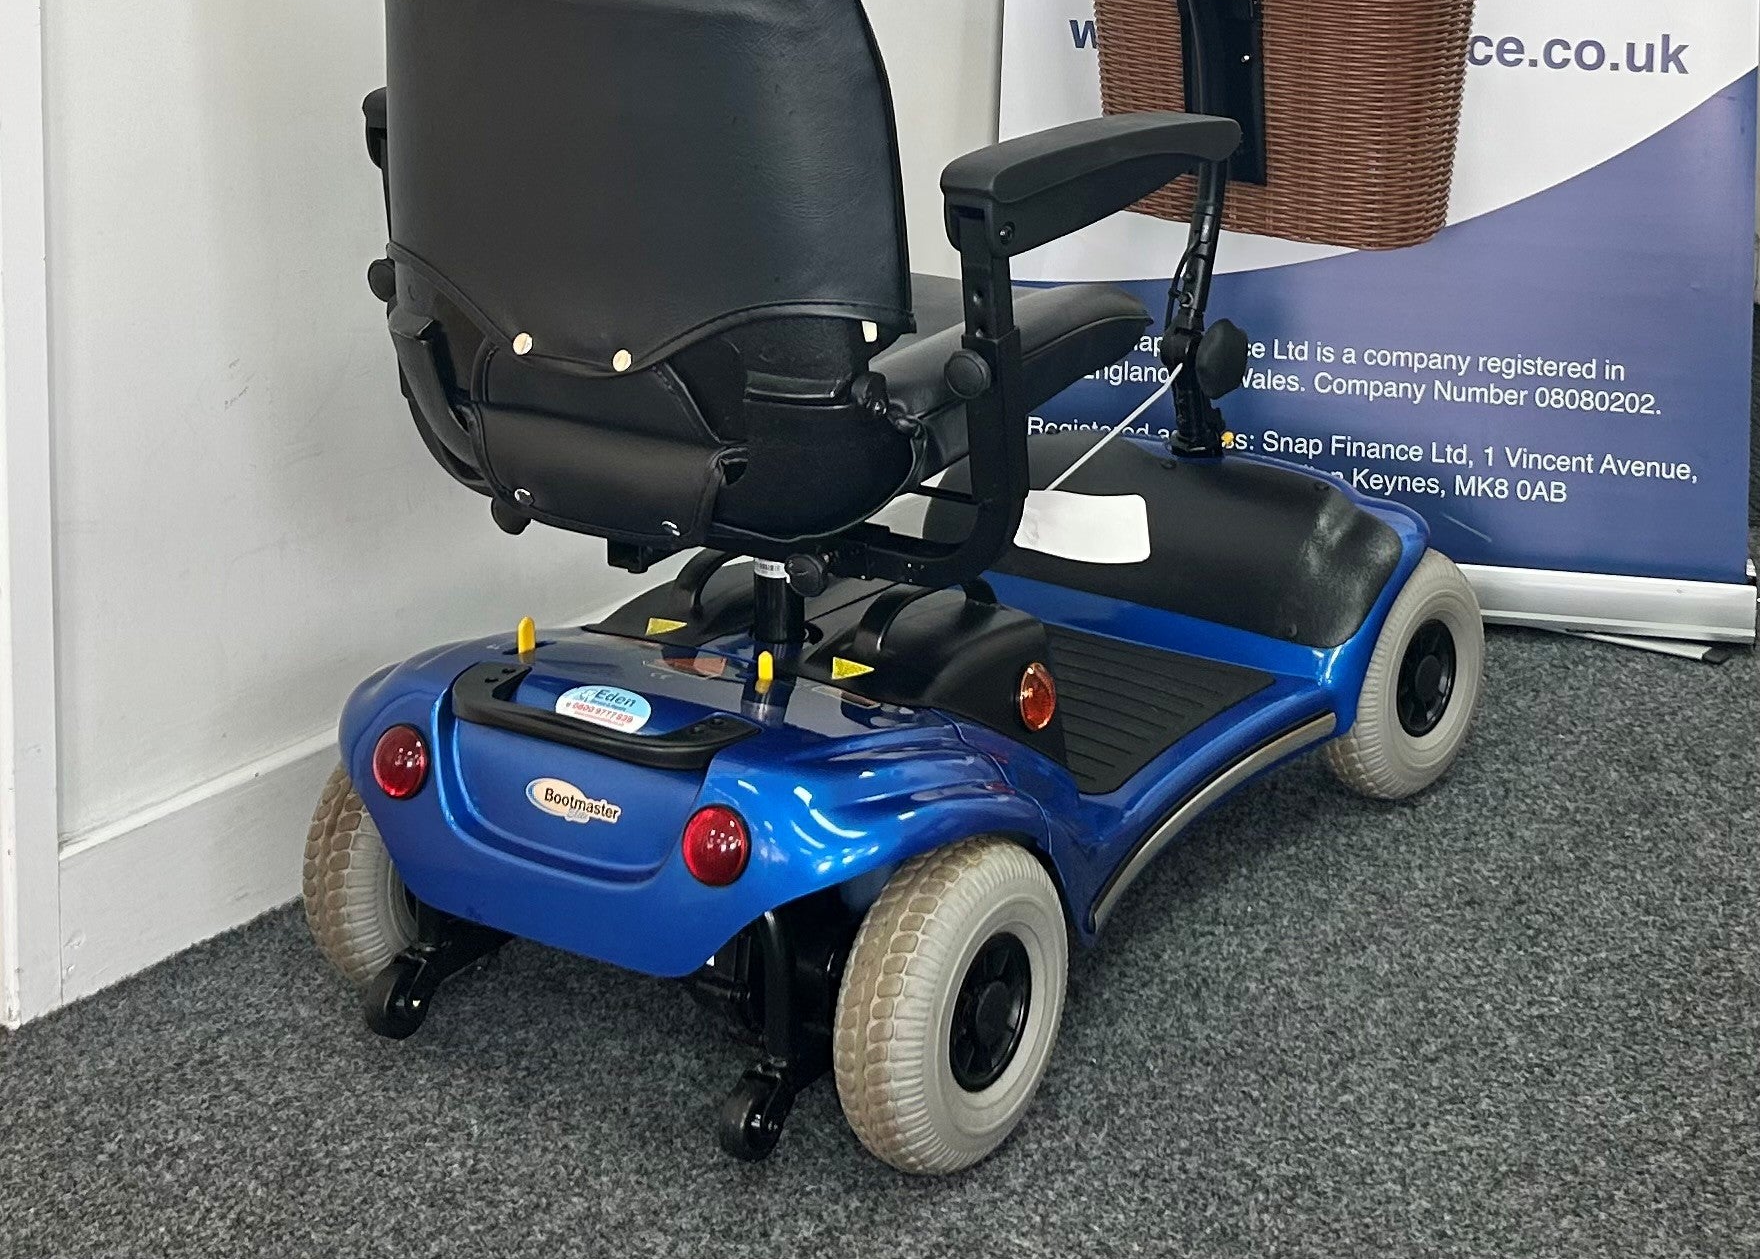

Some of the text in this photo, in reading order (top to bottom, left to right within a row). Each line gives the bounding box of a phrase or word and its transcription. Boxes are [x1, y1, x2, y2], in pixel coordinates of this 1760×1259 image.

[1273, 338, 1309, 361] Ltd
[1316, 341, 1335, 364] is
[1342, 346, 1356, 365] a
[1363, 347, 1471, 376] company
[1478, 353, 1597, 380] registered
[1604, 359, 1625, 381] in
[1314, 371, 1426, 404] Company
[1433, 379, 1528, 406] Number
[1534, 386, 1662, 415] 08080202.
[1262, 430, 1323, 459] Snap
[1331, 434, 1424, 462] Finance
[1431, 442, 1474, 468] Ltd,
[1484, 446, 1494, 466] 1
[1504, 446, 1594, 474] Vincent
[1599, 453, 1698, 484] Avenue,
[1352, 468, 1446, 498] Keynes,
[1454, 474, 1509, 499] MK8
[1516, 479, 1568, 503] 0AB
[594, 689, 637, 708] Eden
[544, 787, 619, 820] Bootmaster
